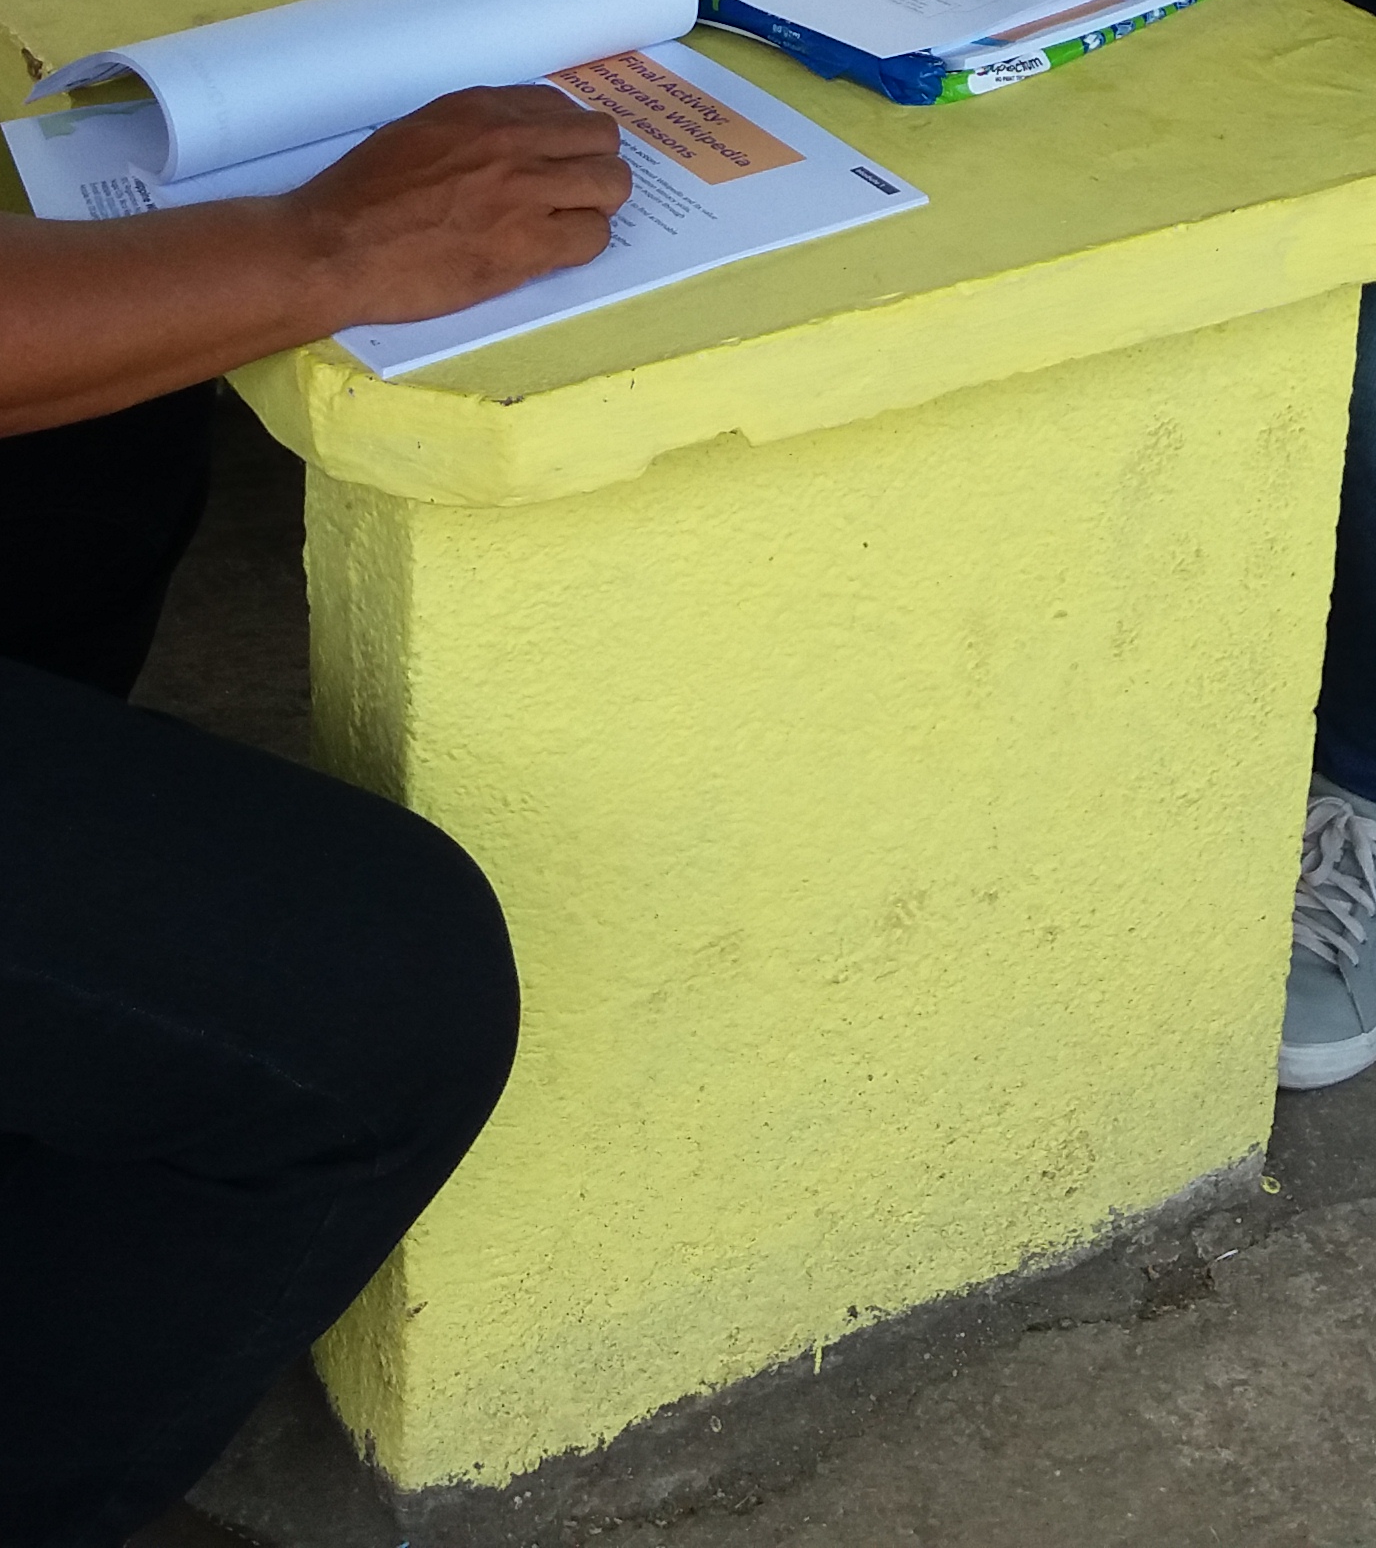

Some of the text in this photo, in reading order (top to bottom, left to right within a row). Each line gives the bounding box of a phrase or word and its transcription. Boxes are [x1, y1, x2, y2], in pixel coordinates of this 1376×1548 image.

[560, 72, 698, 159] into your lessons
[589, 64, 751, 167] Integrate Wikipedia
[619, 56, 730, 125] Final Activity:
